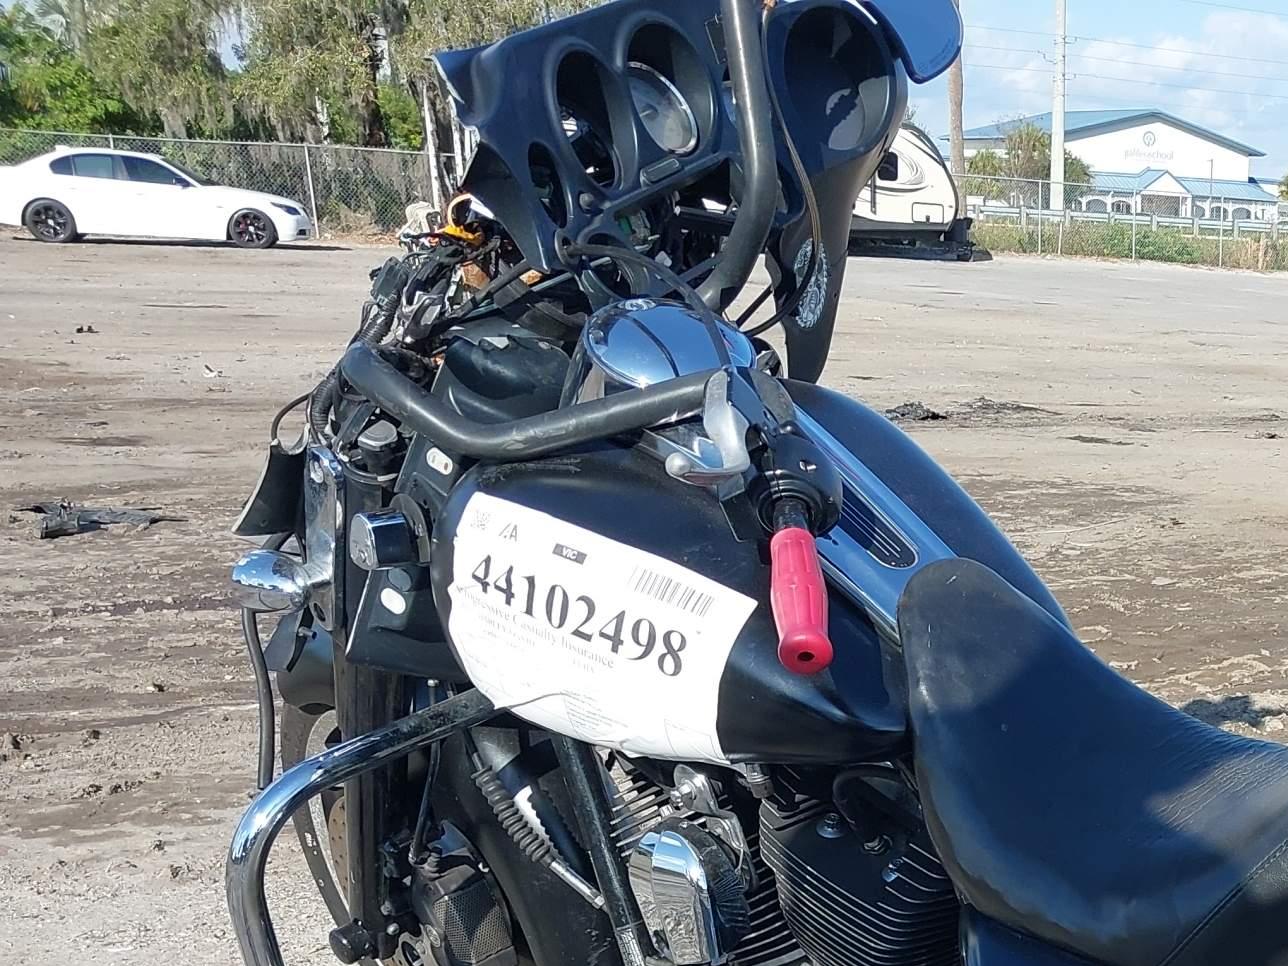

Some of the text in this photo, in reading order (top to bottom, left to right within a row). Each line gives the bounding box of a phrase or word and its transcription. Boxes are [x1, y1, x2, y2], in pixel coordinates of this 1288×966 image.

[562, 545, 578, 560] VIC
[471, 554, 687, 677] 44102498
[561, 635, 615, 669] Insurance
